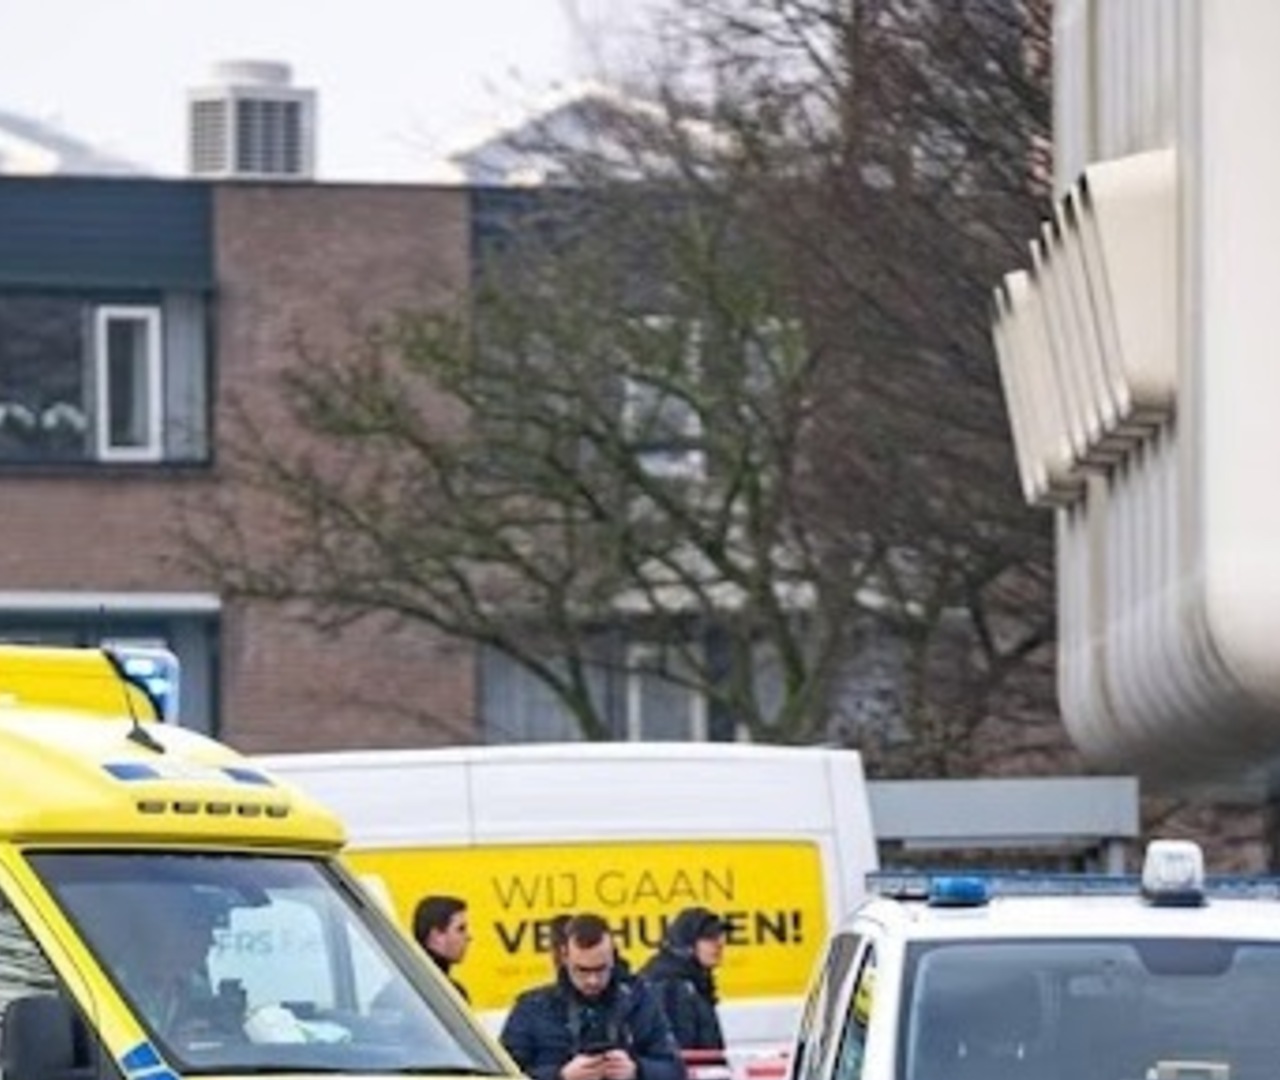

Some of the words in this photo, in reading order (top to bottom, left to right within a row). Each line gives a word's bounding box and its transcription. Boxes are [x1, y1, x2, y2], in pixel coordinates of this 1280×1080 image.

[492, 874, 578, 909] WIJ
[594, 868, 736, 907] GAAN
[494, 909, 804, 954] VEHUEN!
